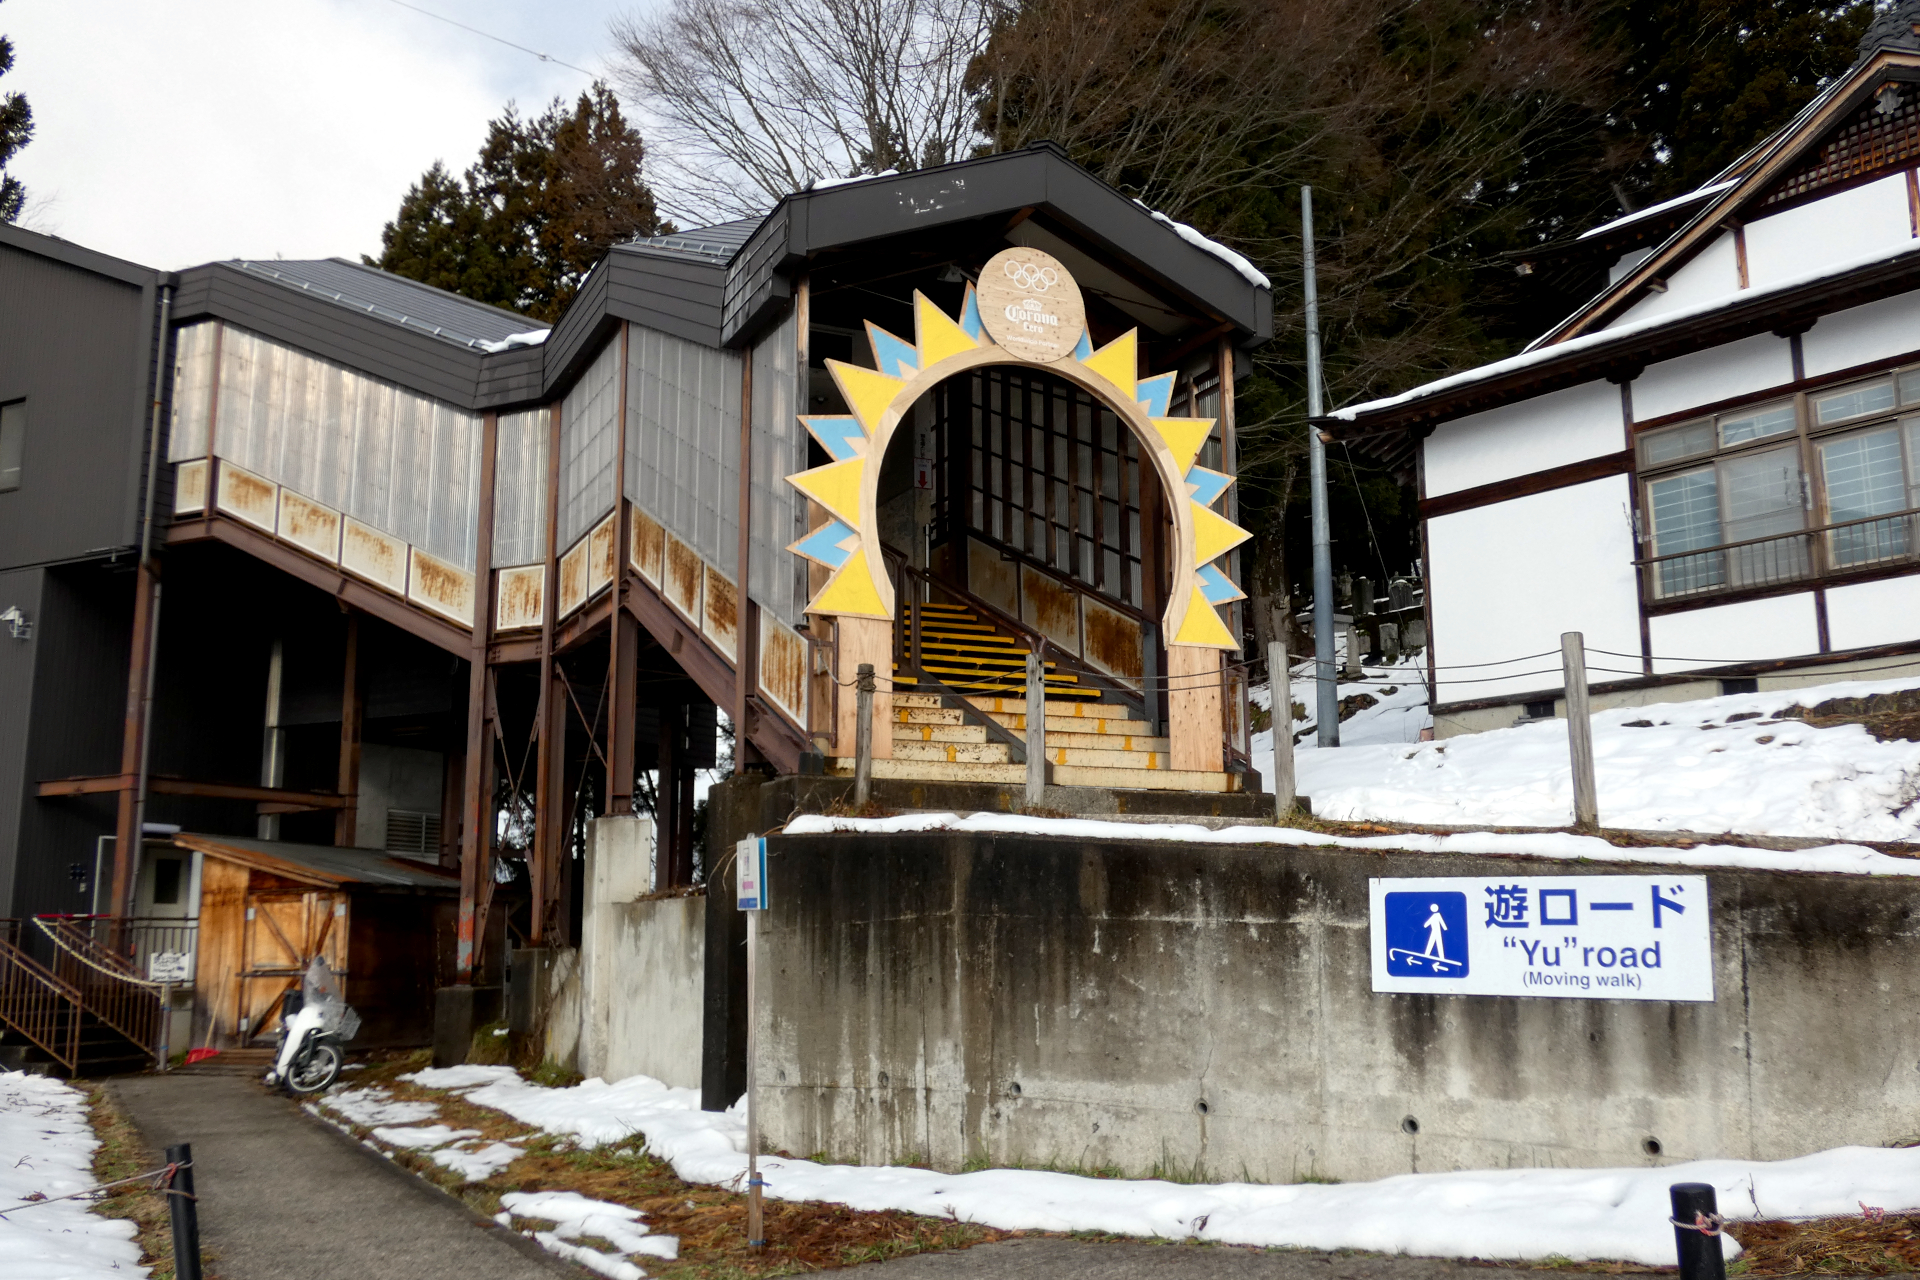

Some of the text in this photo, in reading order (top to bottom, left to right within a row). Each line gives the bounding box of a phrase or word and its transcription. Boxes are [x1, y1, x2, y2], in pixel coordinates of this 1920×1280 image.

[1005, 304, 1058, 326] Corona
[1023, 321, 1043, 333] Cero
[1484, 884, 1686, 929] 遊ロード
[1522, 971, 1642, 990] (Moving walk)
